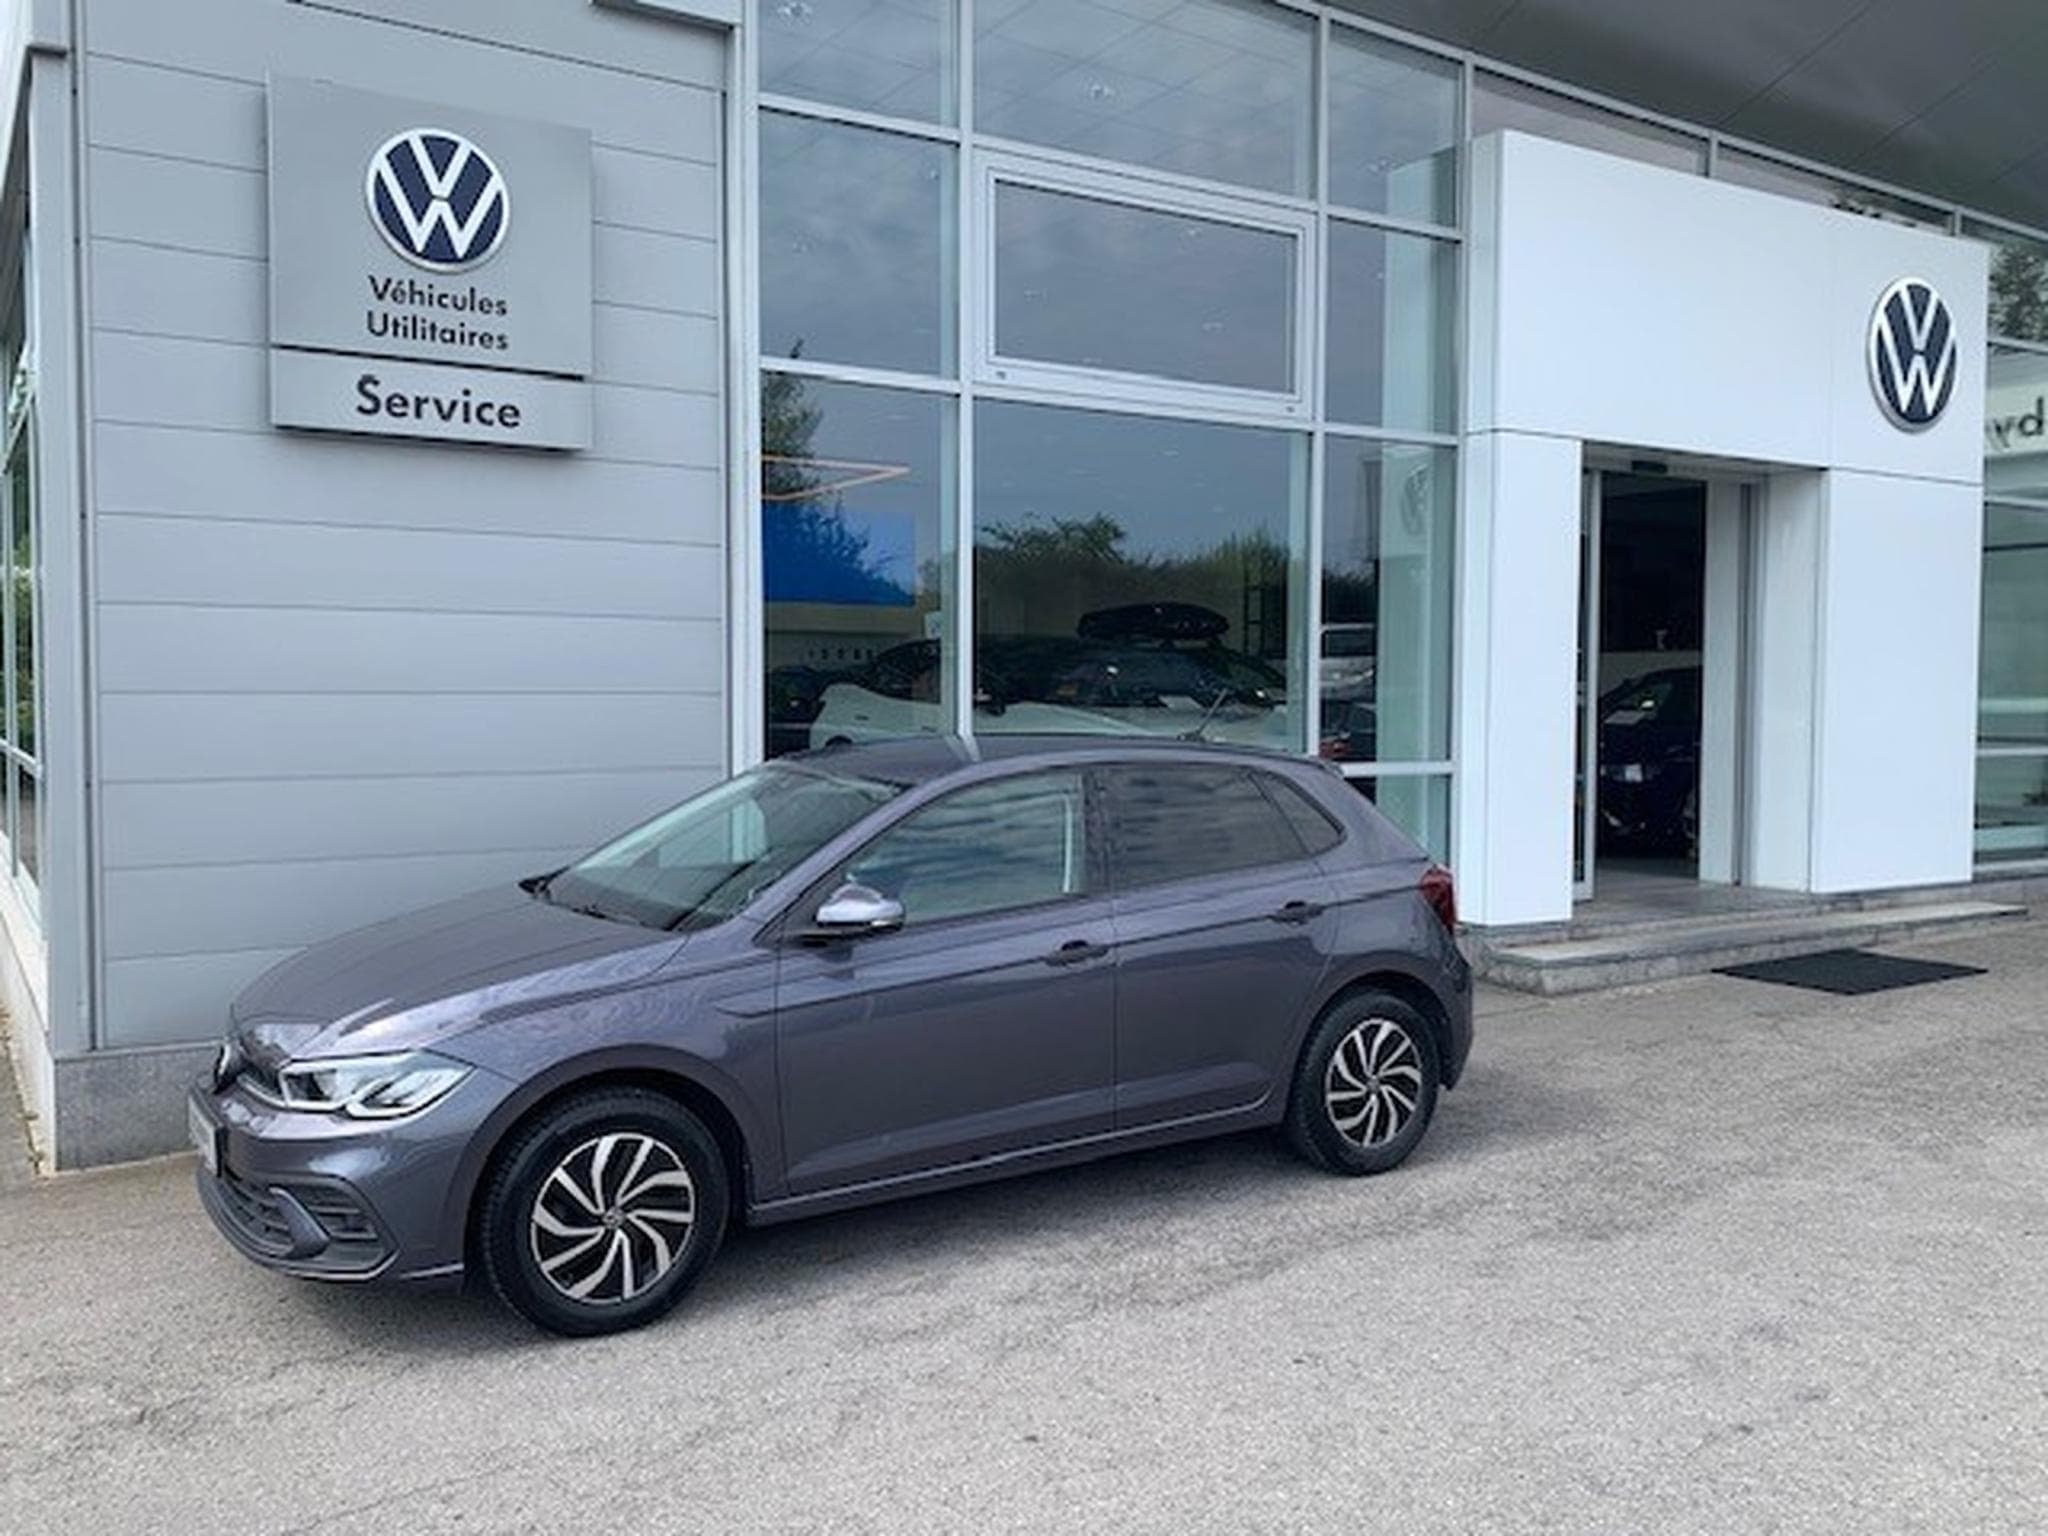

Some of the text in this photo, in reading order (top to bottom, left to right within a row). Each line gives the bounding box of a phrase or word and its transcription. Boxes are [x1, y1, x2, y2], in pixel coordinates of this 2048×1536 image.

[370, 130, 507, 268] VW
[367, 274, 508, 316] Véhicules
[366, 310, 509, 351] Utilitaires
[1873, 279, 1956, 422] VW
[355, 374, 522, 428] Service
